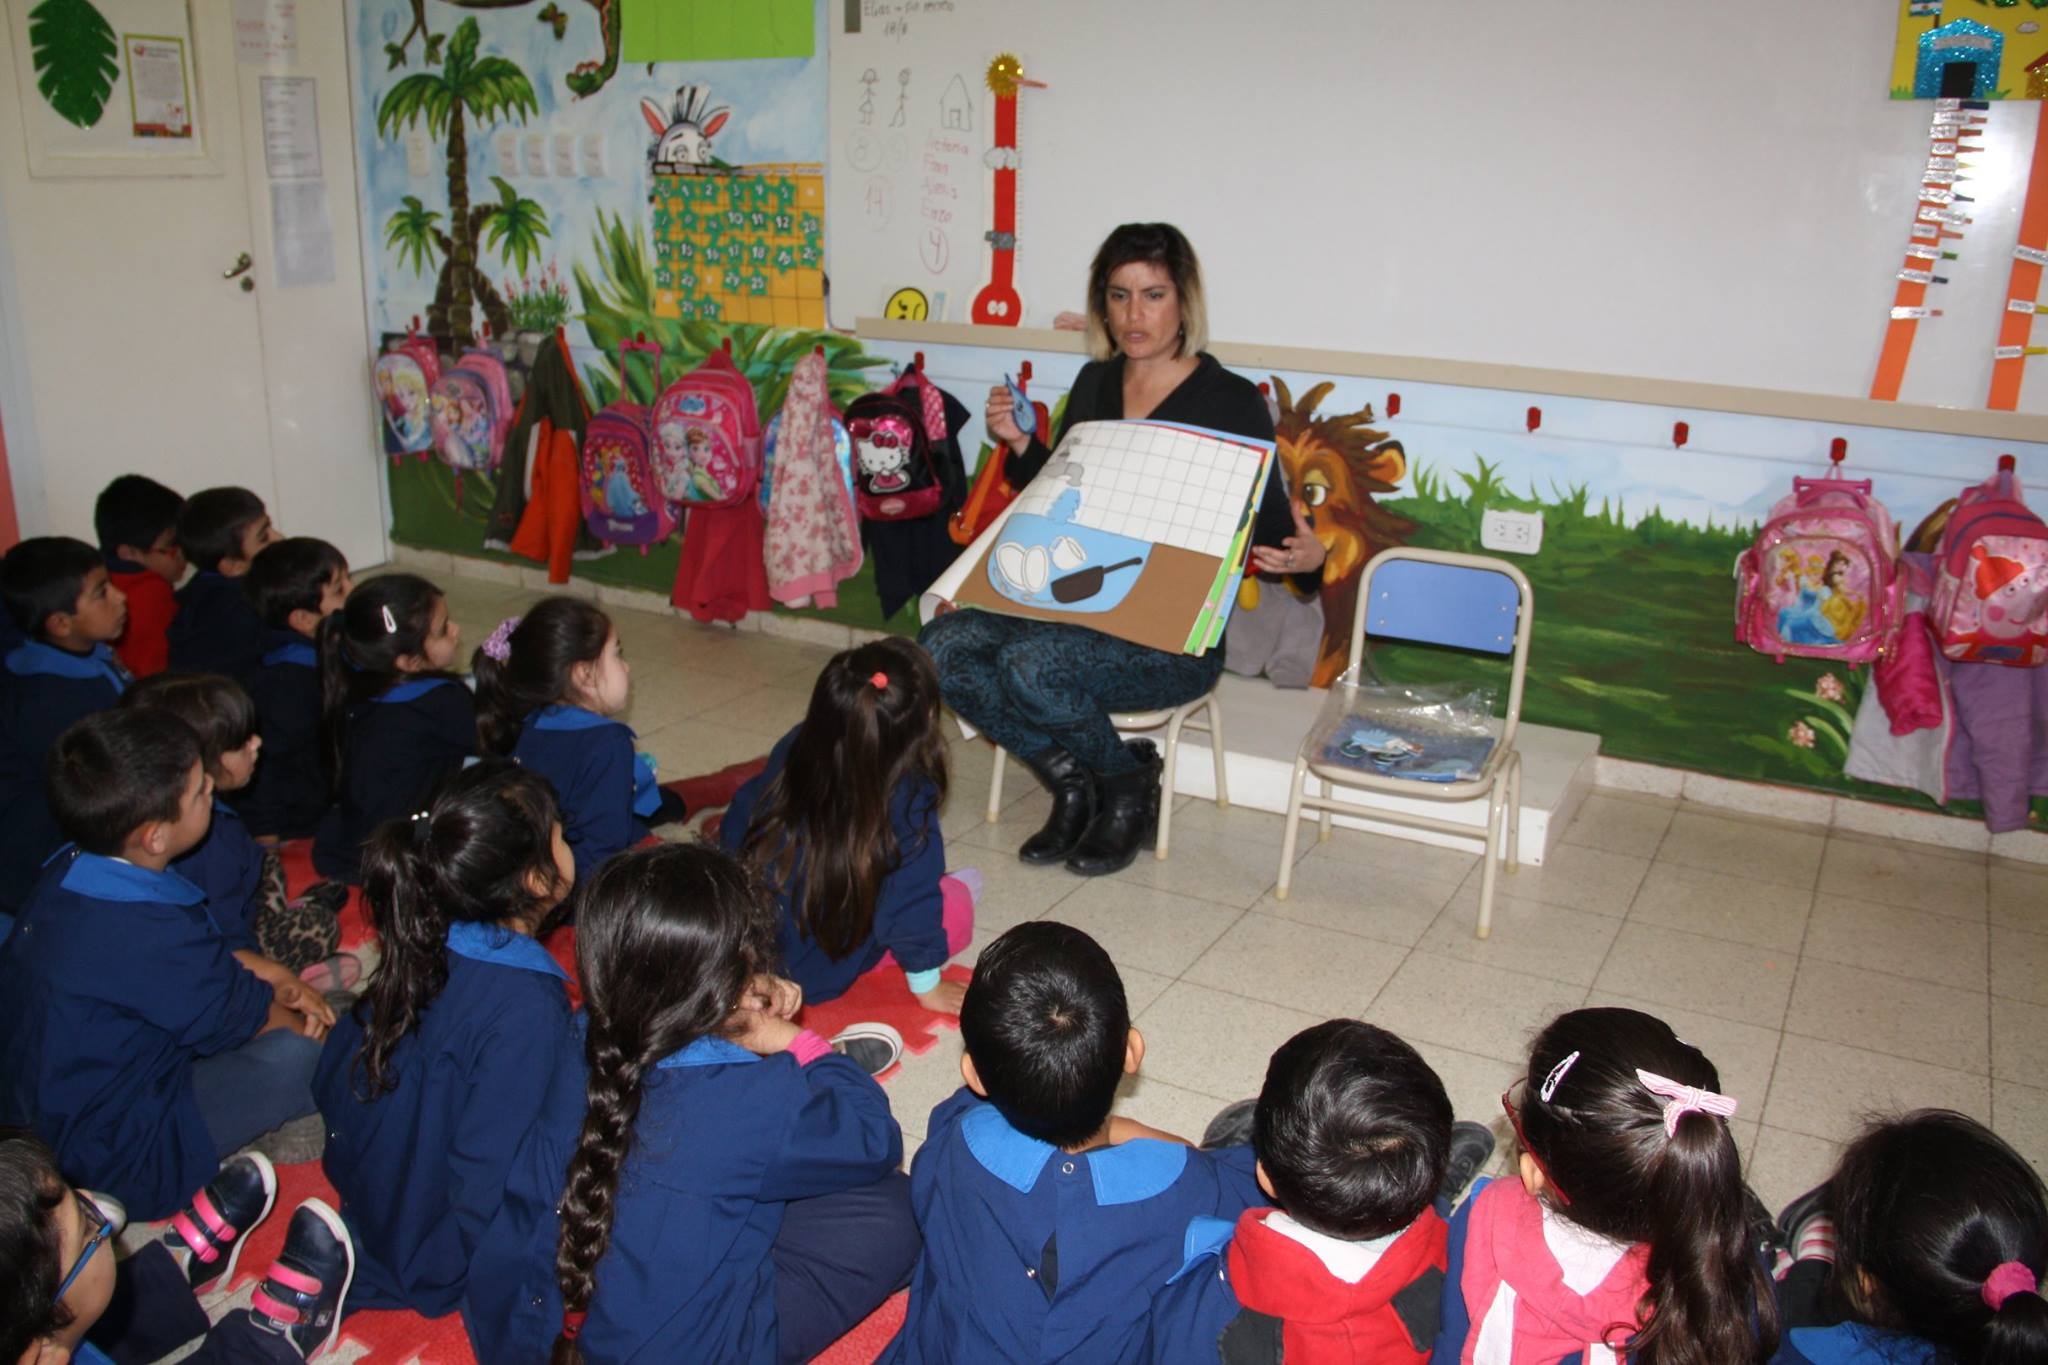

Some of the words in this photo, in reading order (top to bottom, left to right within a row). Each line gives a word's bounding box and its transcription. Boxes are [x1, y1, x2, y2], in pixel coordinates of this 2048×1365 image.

[705, 184, 713, 196] 2
[728, 212, 743, 225] 10
[752, 213, 763, 225] 11
[776, 215, 789, 229] 12
[752, 246, 765, 259] 18
